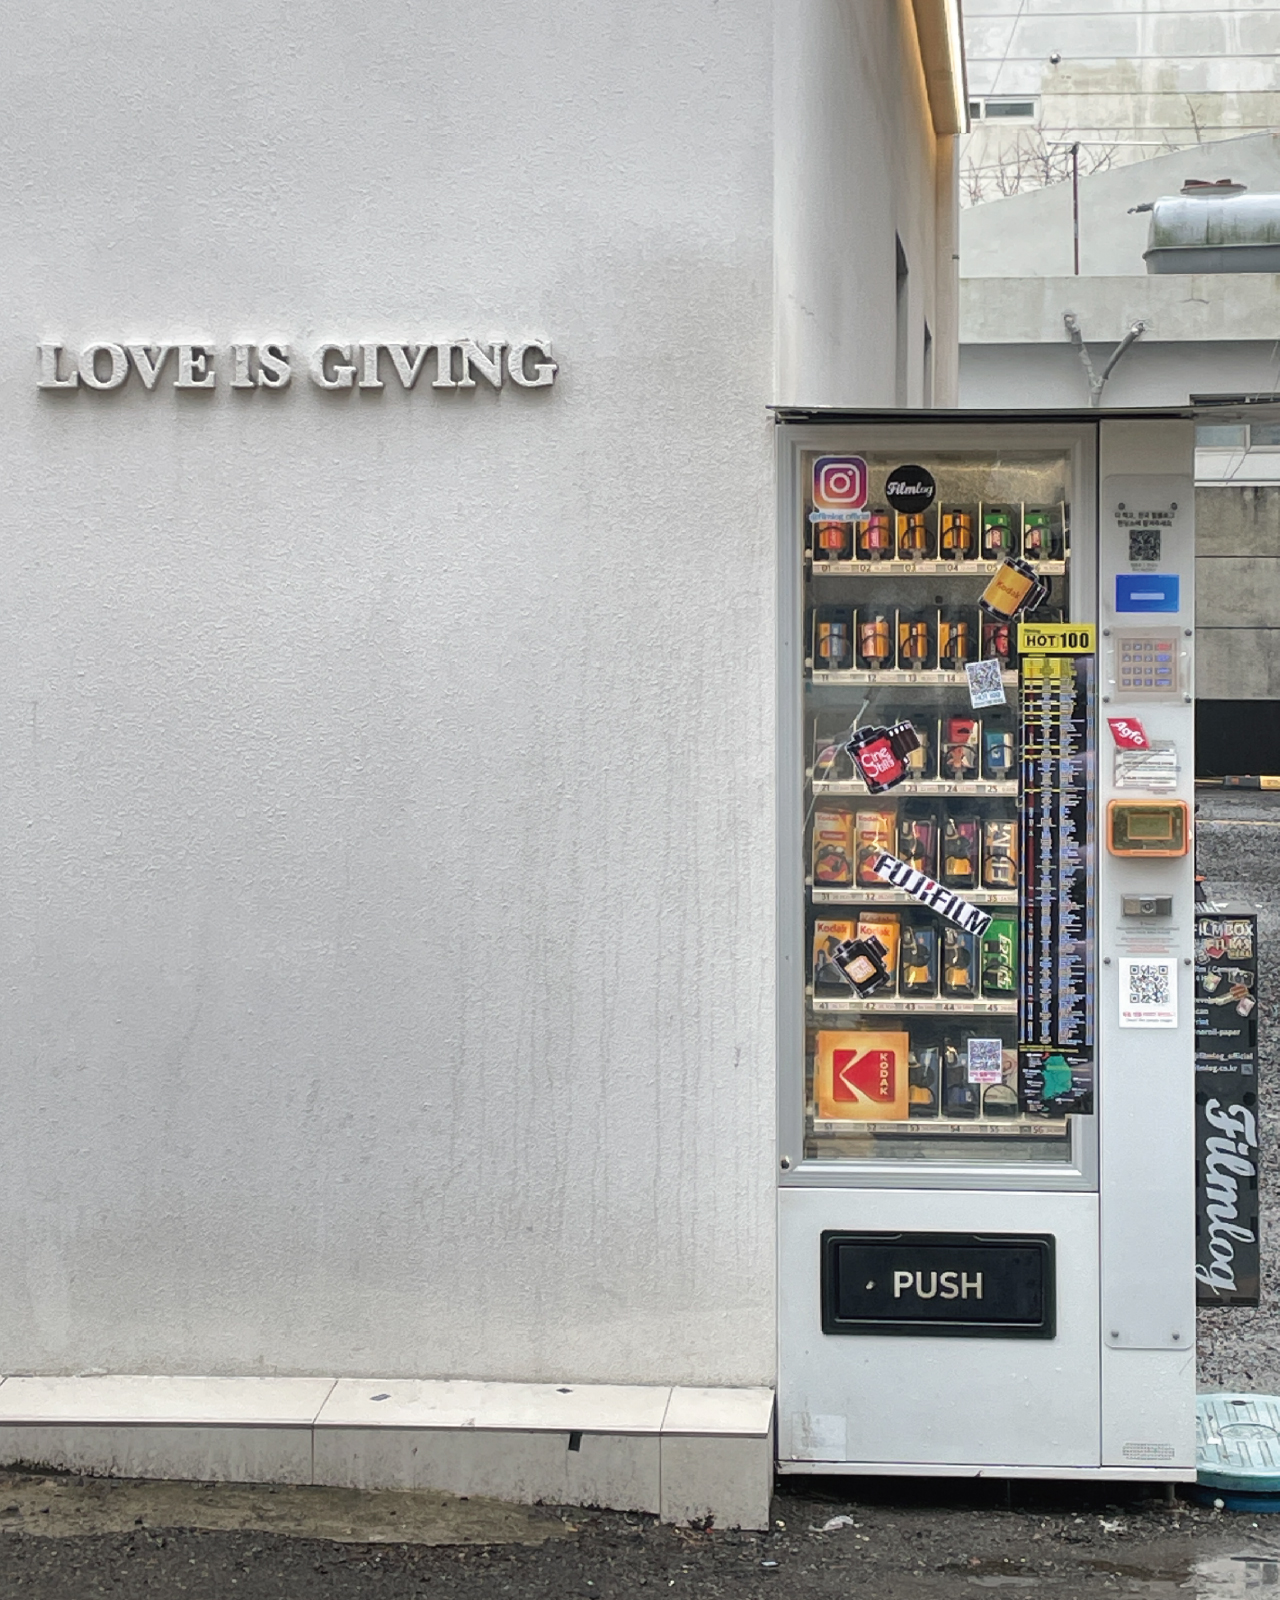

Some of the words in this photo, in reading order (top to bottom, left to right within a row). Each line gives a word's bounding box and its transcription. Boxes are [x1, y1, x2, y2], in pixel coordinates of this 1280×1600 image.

[37, 342, 217, 391] LOVE
[229, 342, 292, 390] IS
[310, 337, 559, 391] GIVING
[886, 482, 934, 497] Filmlog
[995, 580, 1021, 599] Kodak
[1027, 635, 1056, 647] HOT
[1060, 632, 1089, 648] 100
[861, 746, 889, 768] Cine
[873, 852, 989, 937] FUJIFILM
[816, 922, 847, 933] Kodak
[859, 925, 890, 936] Kodak
[1195, 1018, 1209, 1026] rint
[879, 1052, 889, 1096] KODAK
[1195, 1098, 1258, 1296] Filmlog
[892, 1270, 984, 1300] PUSH
